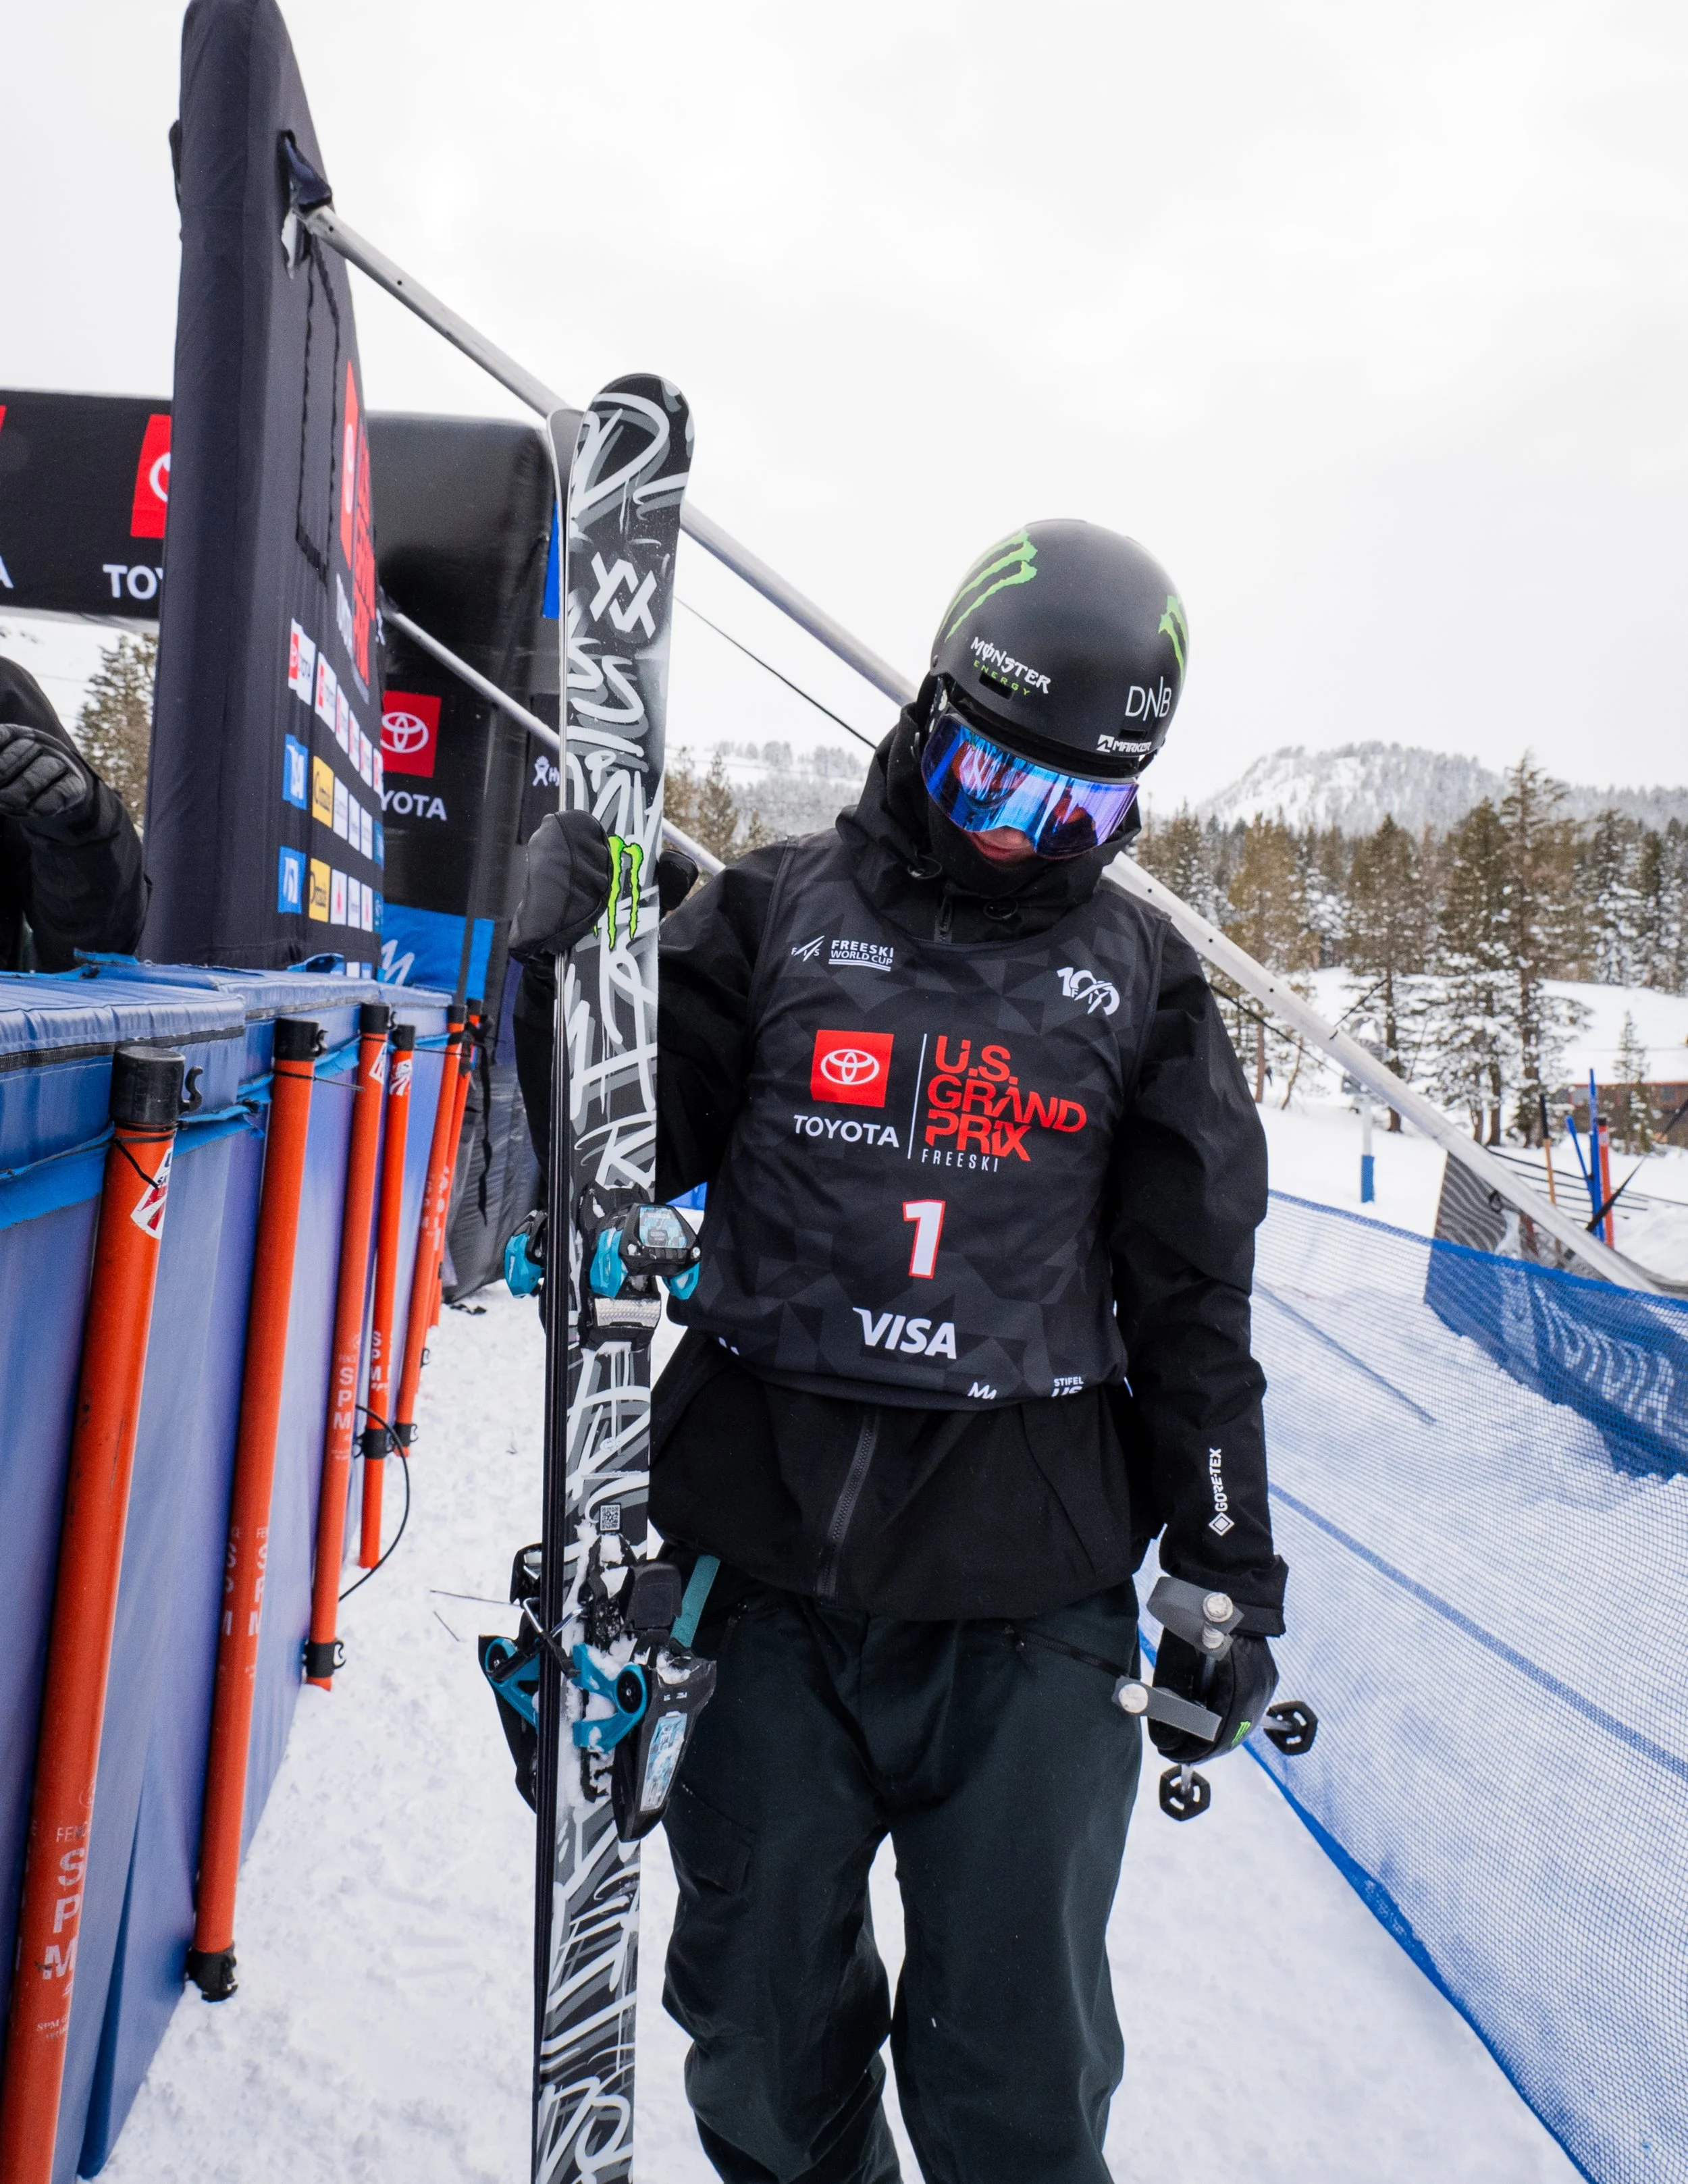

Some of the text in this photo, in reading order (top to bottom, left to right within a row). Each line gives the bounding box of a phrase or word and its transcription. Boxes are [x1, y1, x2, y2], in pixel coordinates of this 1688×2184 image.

[970, 637, 1051, 694] MONSTER
[973, 660, 1030, 695] ENERGY
[1125, 676, 1172, 722] DNB
[1112, 740, 1152, 753] MARKER
[831, 940, 894, 958] FREESKI
[831, 950, 893, 965] WORLD CUP
[935, 1035, 1018, 1086] U.S.
[927, 1073, 1087, 1133] GRAND
[793, 1115, 899, 1148] TOYOTA
[925, 1109, 1032, 1162] PRIX
[922, 1148, 999, 1172] FREESKI
[902, 1199, 946, 1279] 1
[852, 1307, 957, 1360] VISA
[1053, 1376, 1084, 1387] STIFEL
[1209, 1447, 1228, 1512] GORE-TEX
